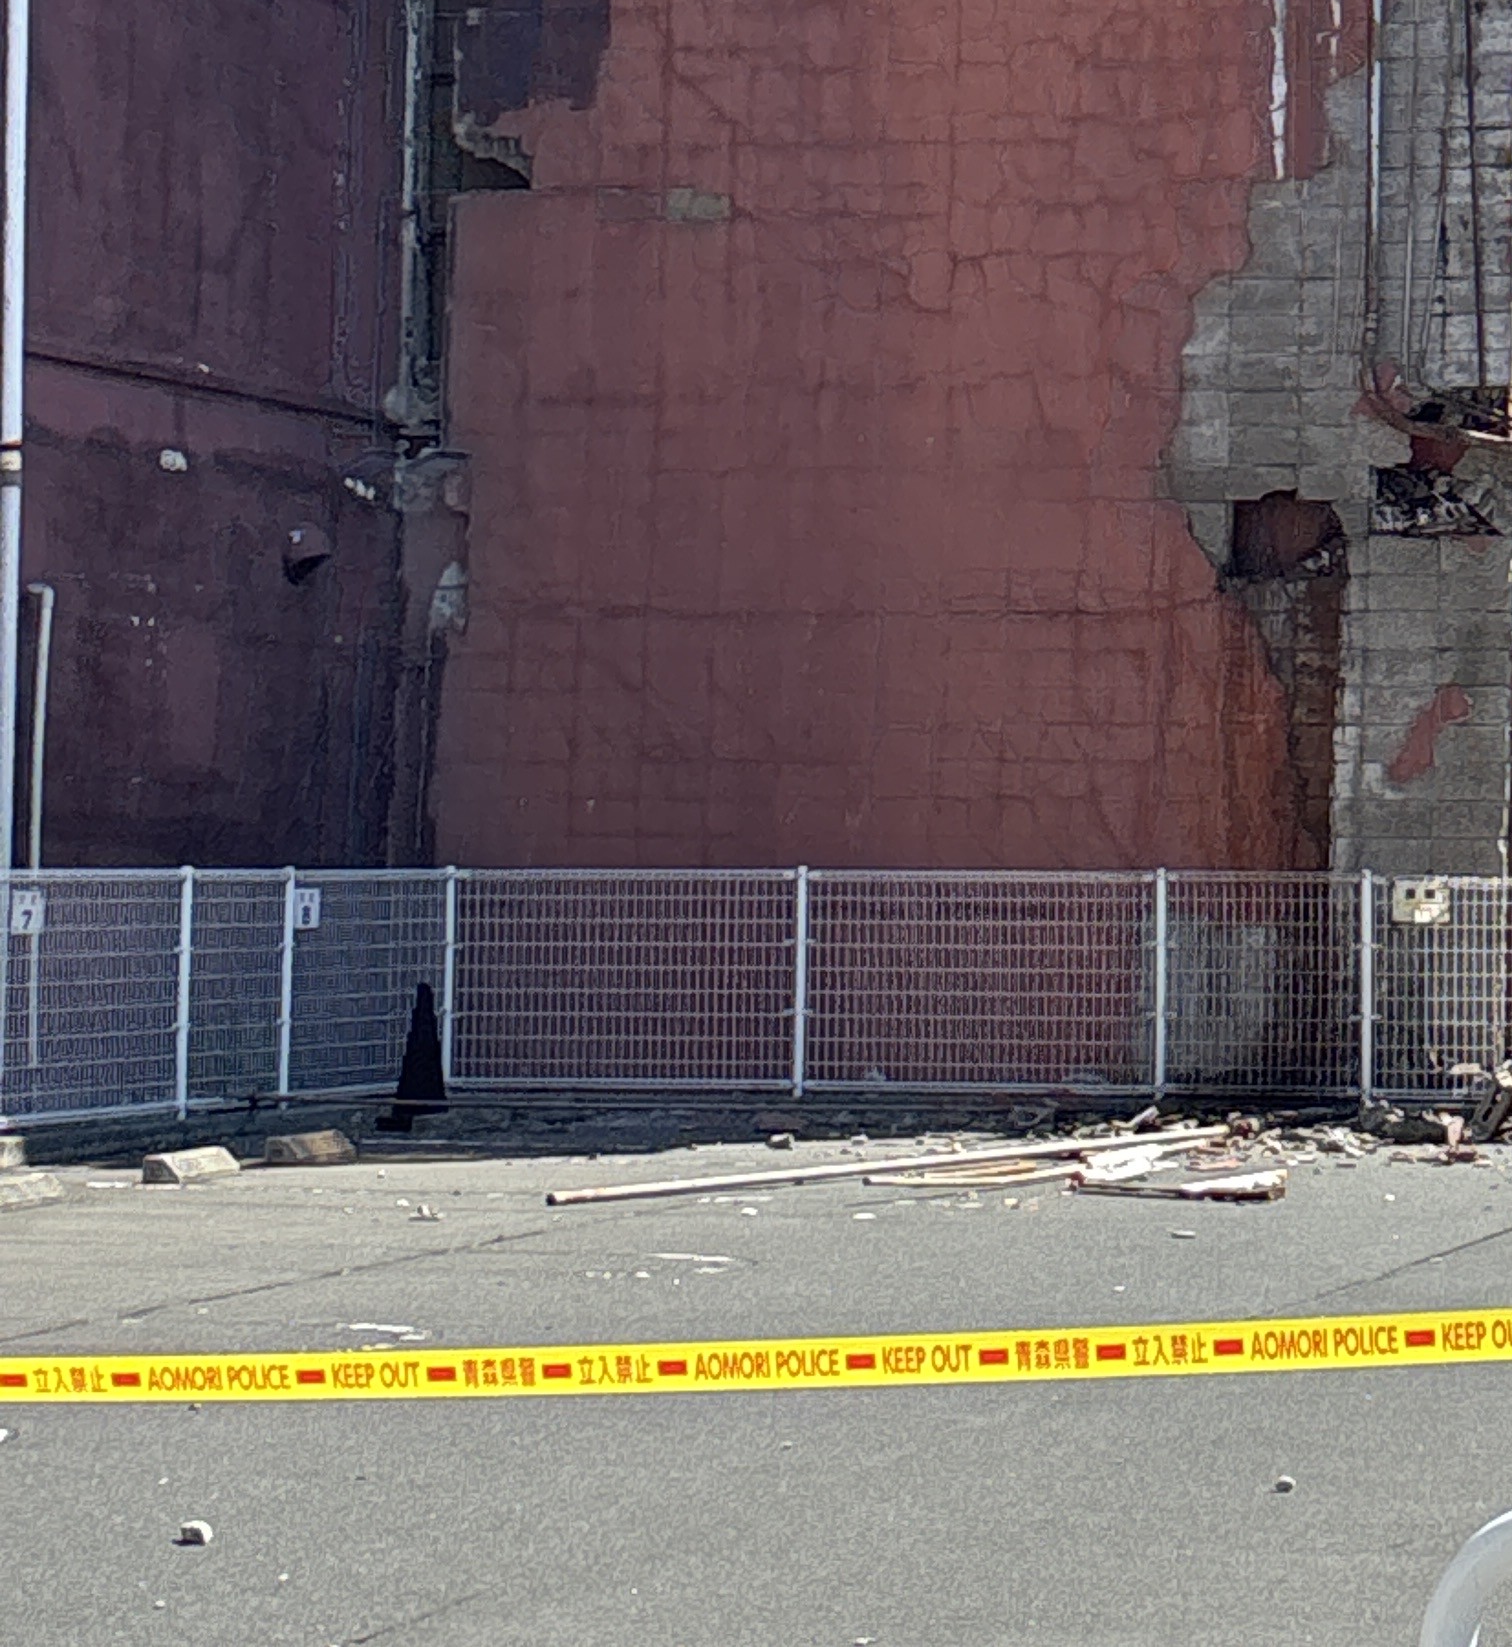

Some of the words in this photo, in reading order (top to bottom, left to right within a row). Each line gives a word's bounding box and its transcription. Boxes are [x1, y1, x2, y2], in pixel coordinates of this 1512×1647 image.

[22, 909, 33, 930] 7
[1133, 1333, 1206, 1366] 立入禁止
[1253, 1330, 1327, 1358] AOMORI
[1334, 1326, 1396, 1354] POLICE
[1443, 1322, 1486, 1350] KEEP
[579, 1355, 651, 1384] 立入禁止
[696, 1352, 770, 1379] AOMORI
[776, 1349, 839, 1376] POLICE
[882, 1346, 926, 1374] KEEP
[931, 1344, 971, 1372] OUT
[148, 1366, 223, 1391] AOMORI
[227, 1365, 289, 1389] POLICE
[332, 1363, 375, 1388] KEEP
[380, 1362, 419, 1387] OUT
